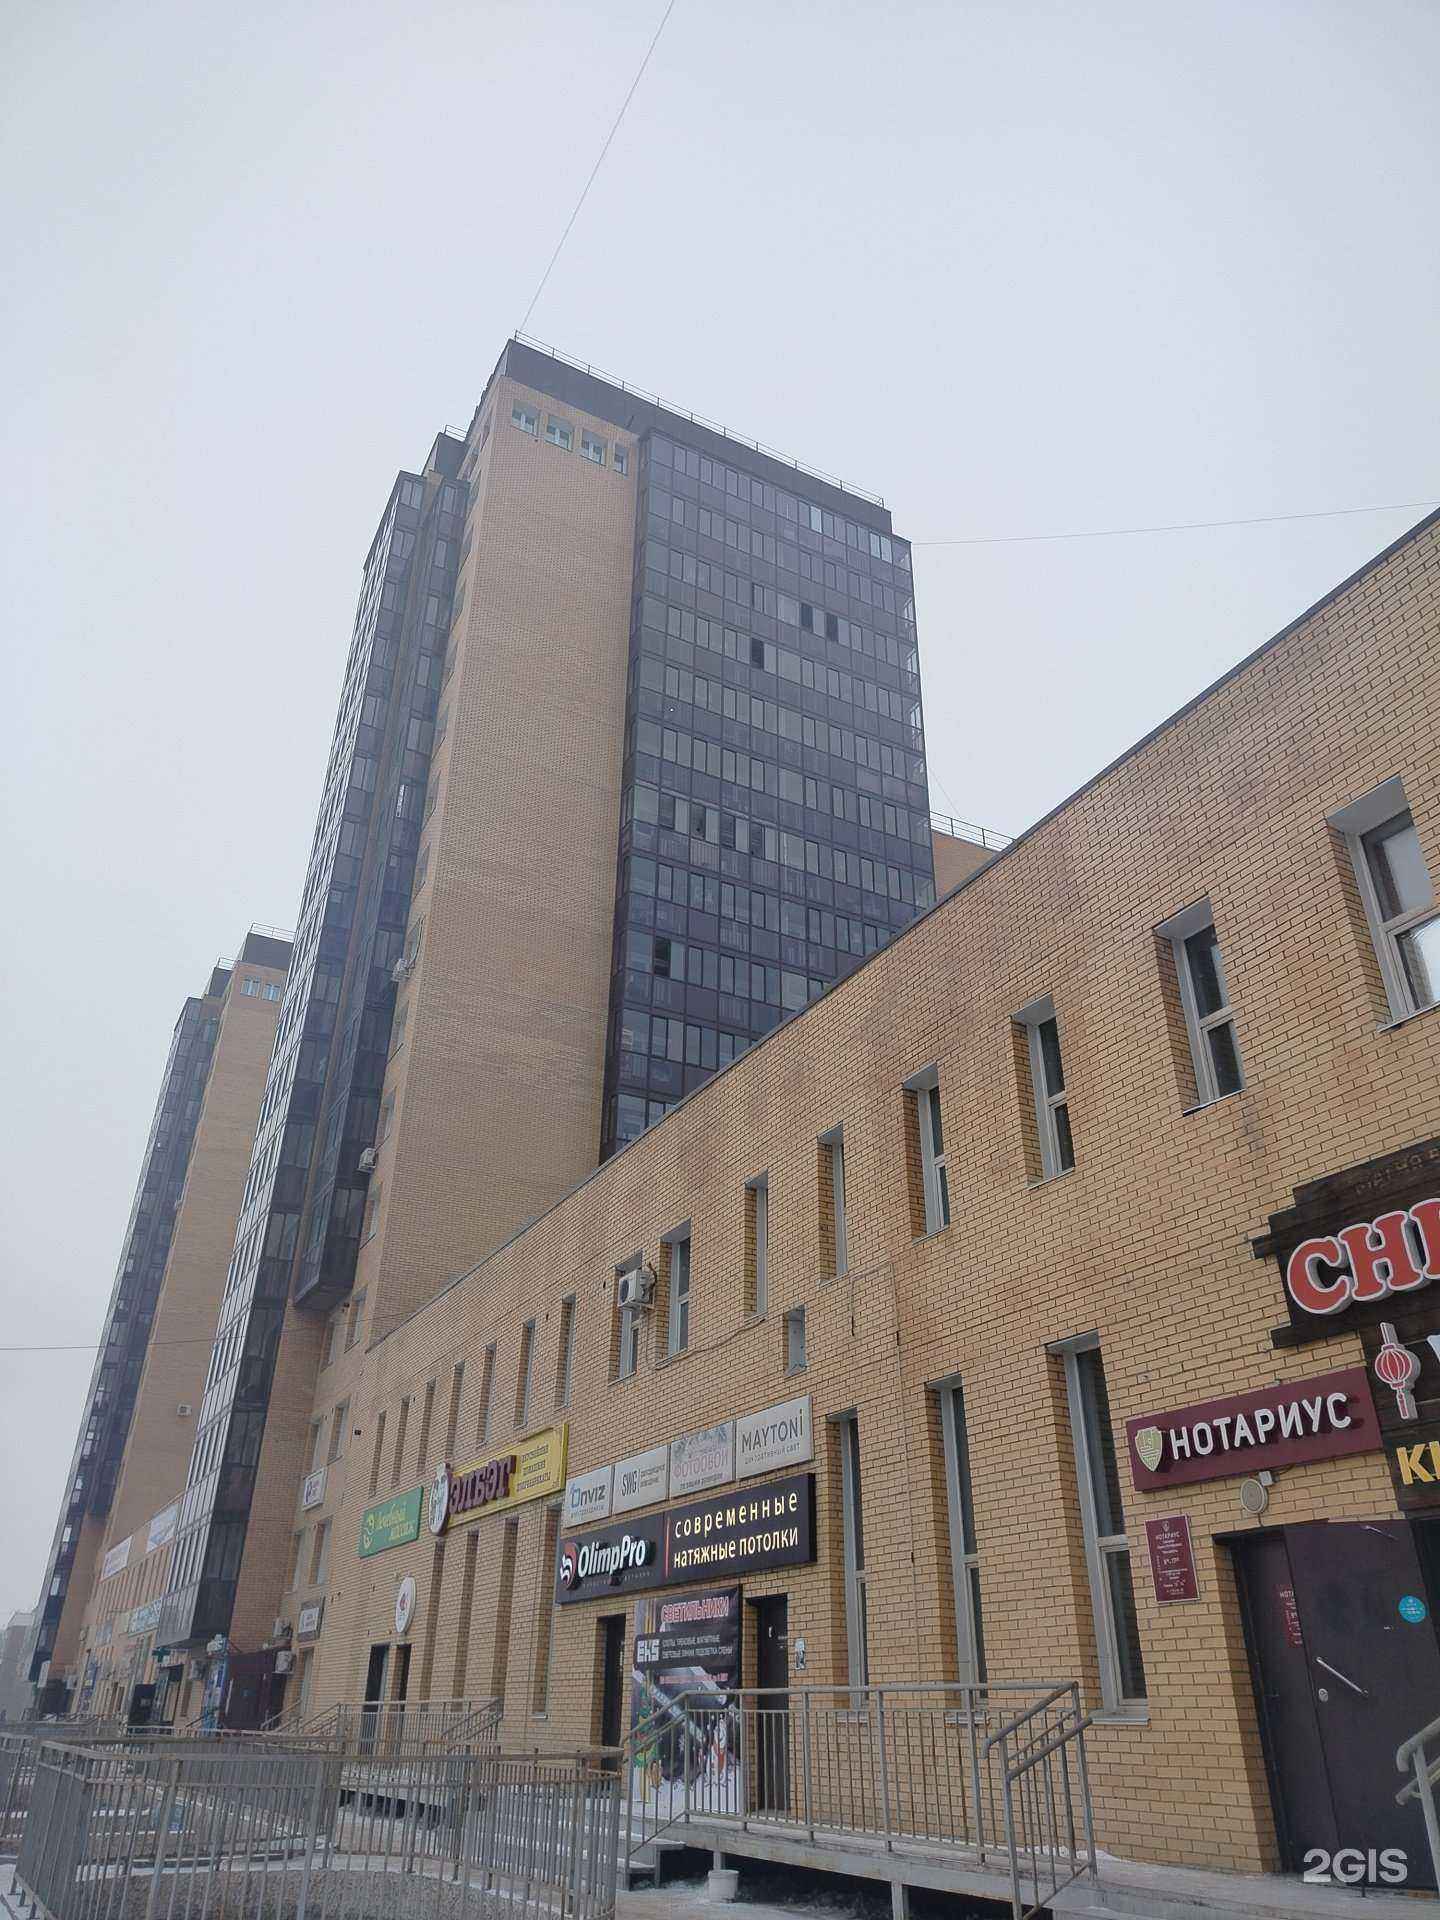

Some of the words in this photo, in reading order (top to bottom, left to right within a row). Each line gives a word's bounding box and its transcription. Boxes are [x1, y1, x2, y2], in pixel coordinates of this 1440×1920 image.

[1170, 1392, 1351, 1461] НОТАРИУС
[674, 1491, 799, 1540] современные
[577, 1534, 647, 1578] OlimpPro
[673, 1543, 736, 1570] натяжные
[738, 1526, 799, 1557] потолки
[661, 1596, 729, 1624] СВЕТИЛЬНИКИ
